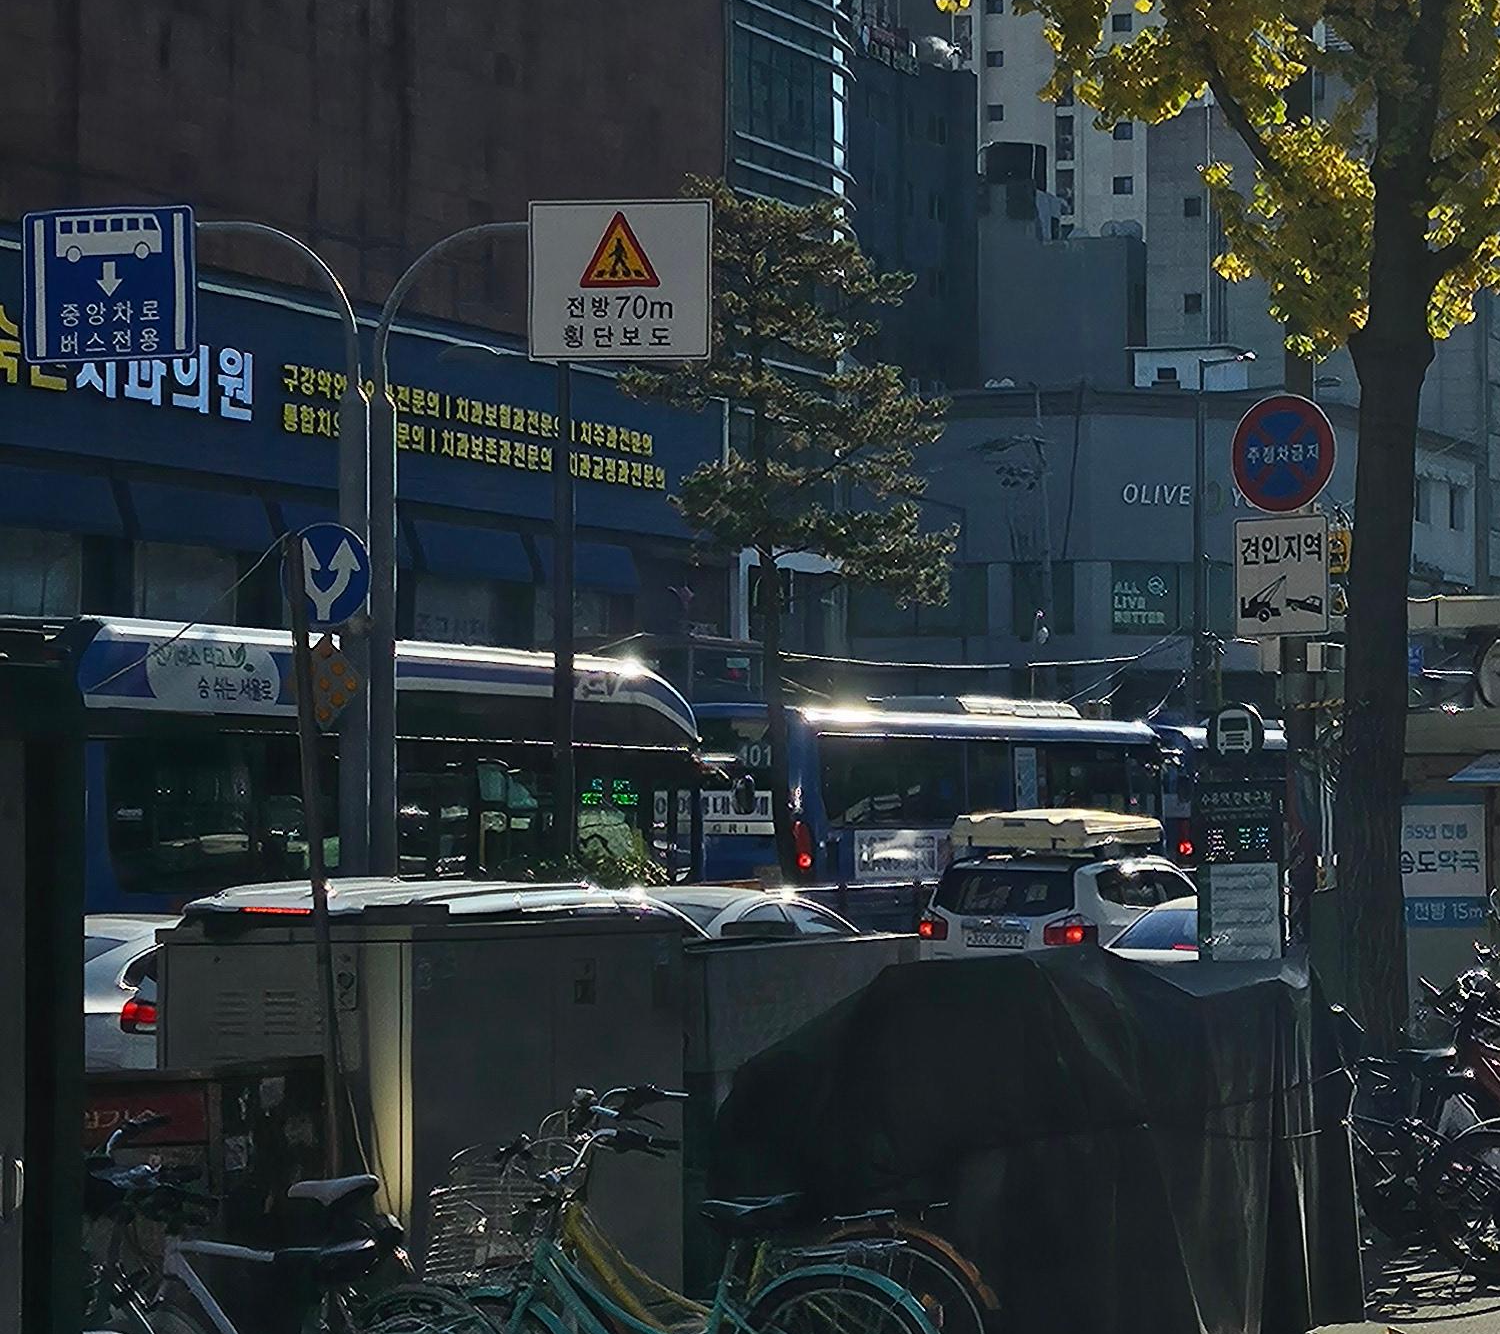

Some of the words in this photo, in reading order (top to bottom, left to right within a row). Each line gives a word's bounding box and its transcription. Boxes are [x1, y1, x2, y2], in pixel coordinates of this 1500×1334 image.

[60, 300, 160, 327] 중앙차로
[60, 327, 160, 355] 버스전용
[564, 325, 672, 348] 횡단보도
[1247, 443, 1319, 465] 주정차금지
[1123, 483, 1191, 505] OLIVE
[1240, 532, 1322, 565] 견인지역
[1452, 902, 1483, 919] 15m
